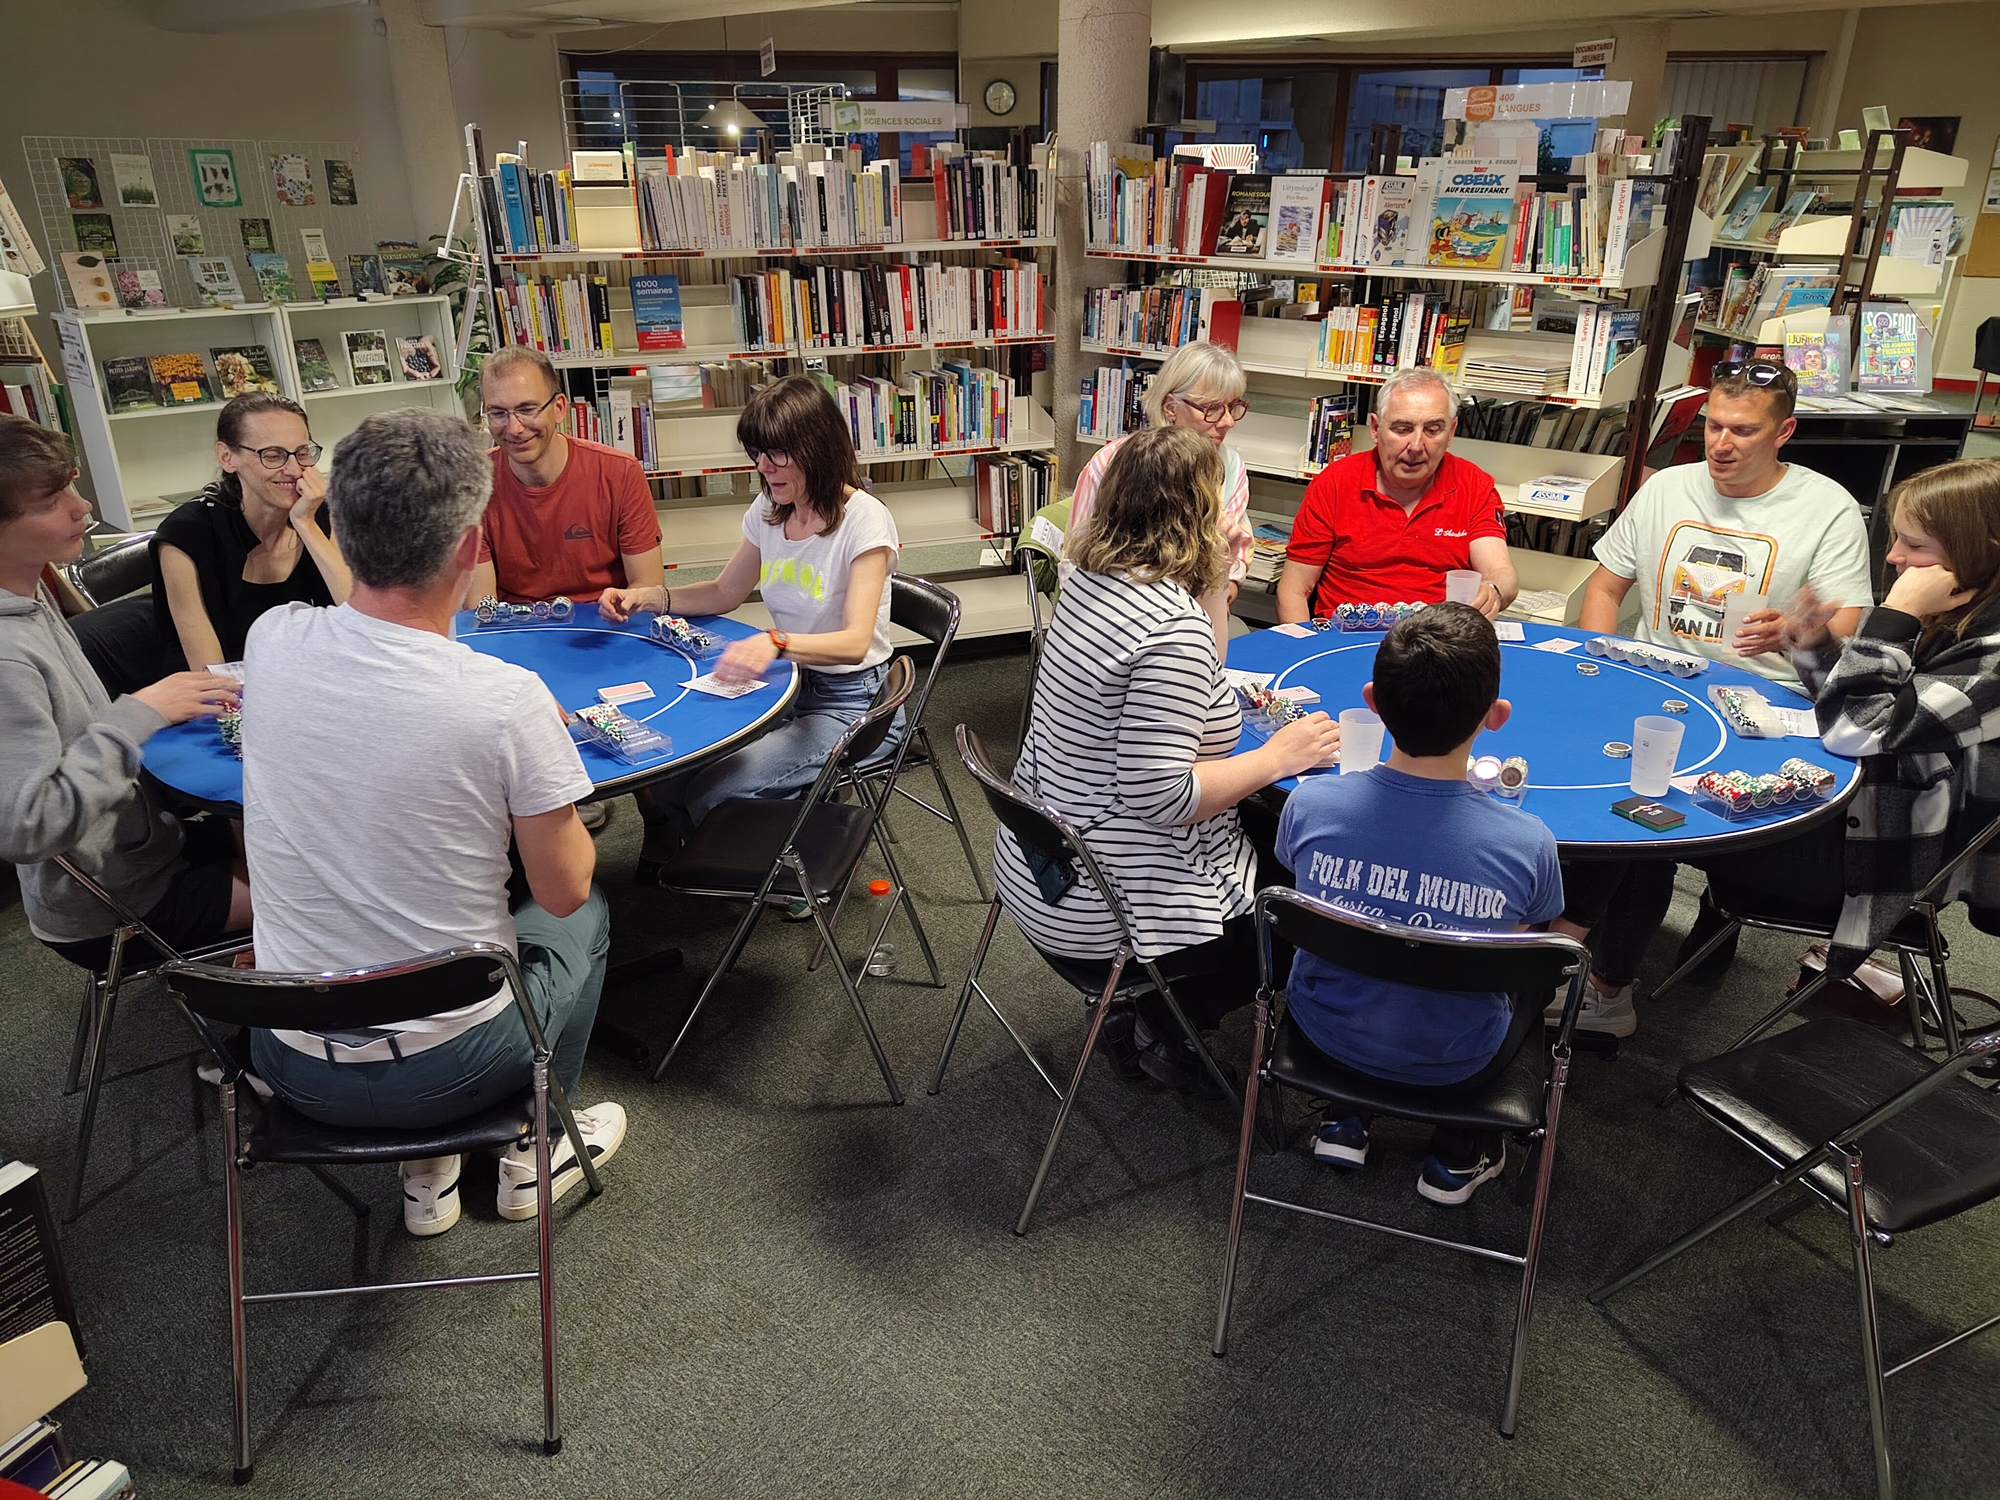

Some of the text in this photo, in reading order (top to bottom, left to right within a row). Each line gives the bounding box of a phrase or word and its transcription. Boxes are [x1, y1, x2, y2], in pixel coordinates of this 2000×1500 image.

[1575, 42, 1613, 54] DOCUMENTAIRES
[1580, 53, 1605, 63] JEUNES
[1498, 103, 1541, 113] LANGUES
[1499, 93, 1514, 102] 400
[863, 108, 876, 116] 300
[863, 117, 942, 126] SCIENCES SOCIALES
[1364, 188, 1373, 220] Allemand
[1614, 183, 1627, 248] HARRAP'S italien
[636, 287, 673, 295] semaines
[1378, 306, 1388, 339] Espagnol
[1389, 308, 1399, 339] Espagnol
[1411, 297, 1420, 329] HARRAP'S
[1612, 312, 1641, 322] HARRAP'S
[1892, 312, 1916, 334] FOOT
[1576, 308, 1591, 377] HARRAP'S portugais
[1597, 315, 1607, 347] HARRAP'S
[1357, 336, 1365, 362] espagnol
[1533, 490, 1566, 502] ASSIMIL
[1668, 615, 1702, 640] VAN
[1308, 850, 1507, 920] FOLK DEL MUNDO
